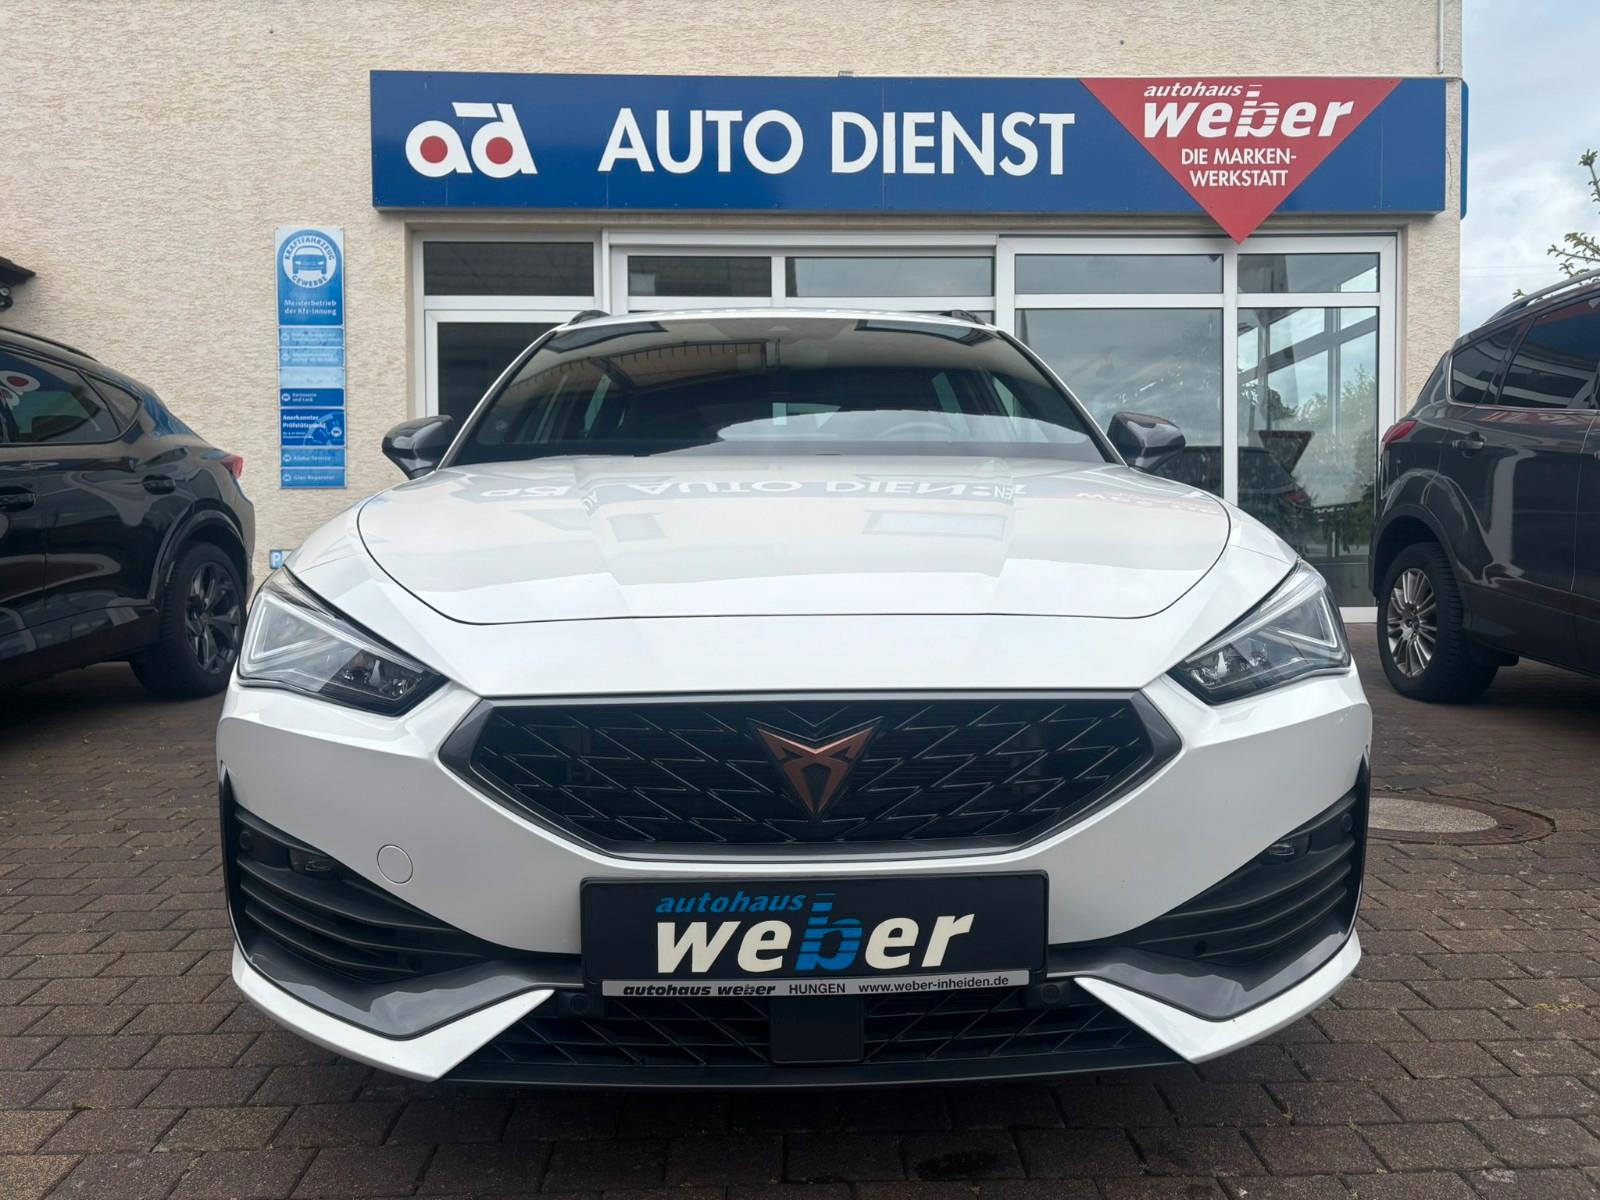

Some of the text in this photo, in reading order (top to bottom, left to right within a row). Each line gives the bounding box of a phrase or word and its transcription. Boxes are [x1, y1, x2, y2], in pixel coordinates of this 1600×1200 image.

[1143, 82, 1243, 97] autohaus
[1143, 84, 1355, 138] weber
[597, 107, 1076, 177] AUTO DIENST
[1181, 148, 1297, 165] DIE MARKEN-
[1189, 169, 1289, 187] WERKSTATT
[284, 299, 337, 307] Meisterbetrieb
[655, 891, 807, 915] autohaus
[656, 893, 976, 974] weber
[623, 975, 1009, 996] autohaus weber HUNGEN www.weber-inheiden.de
